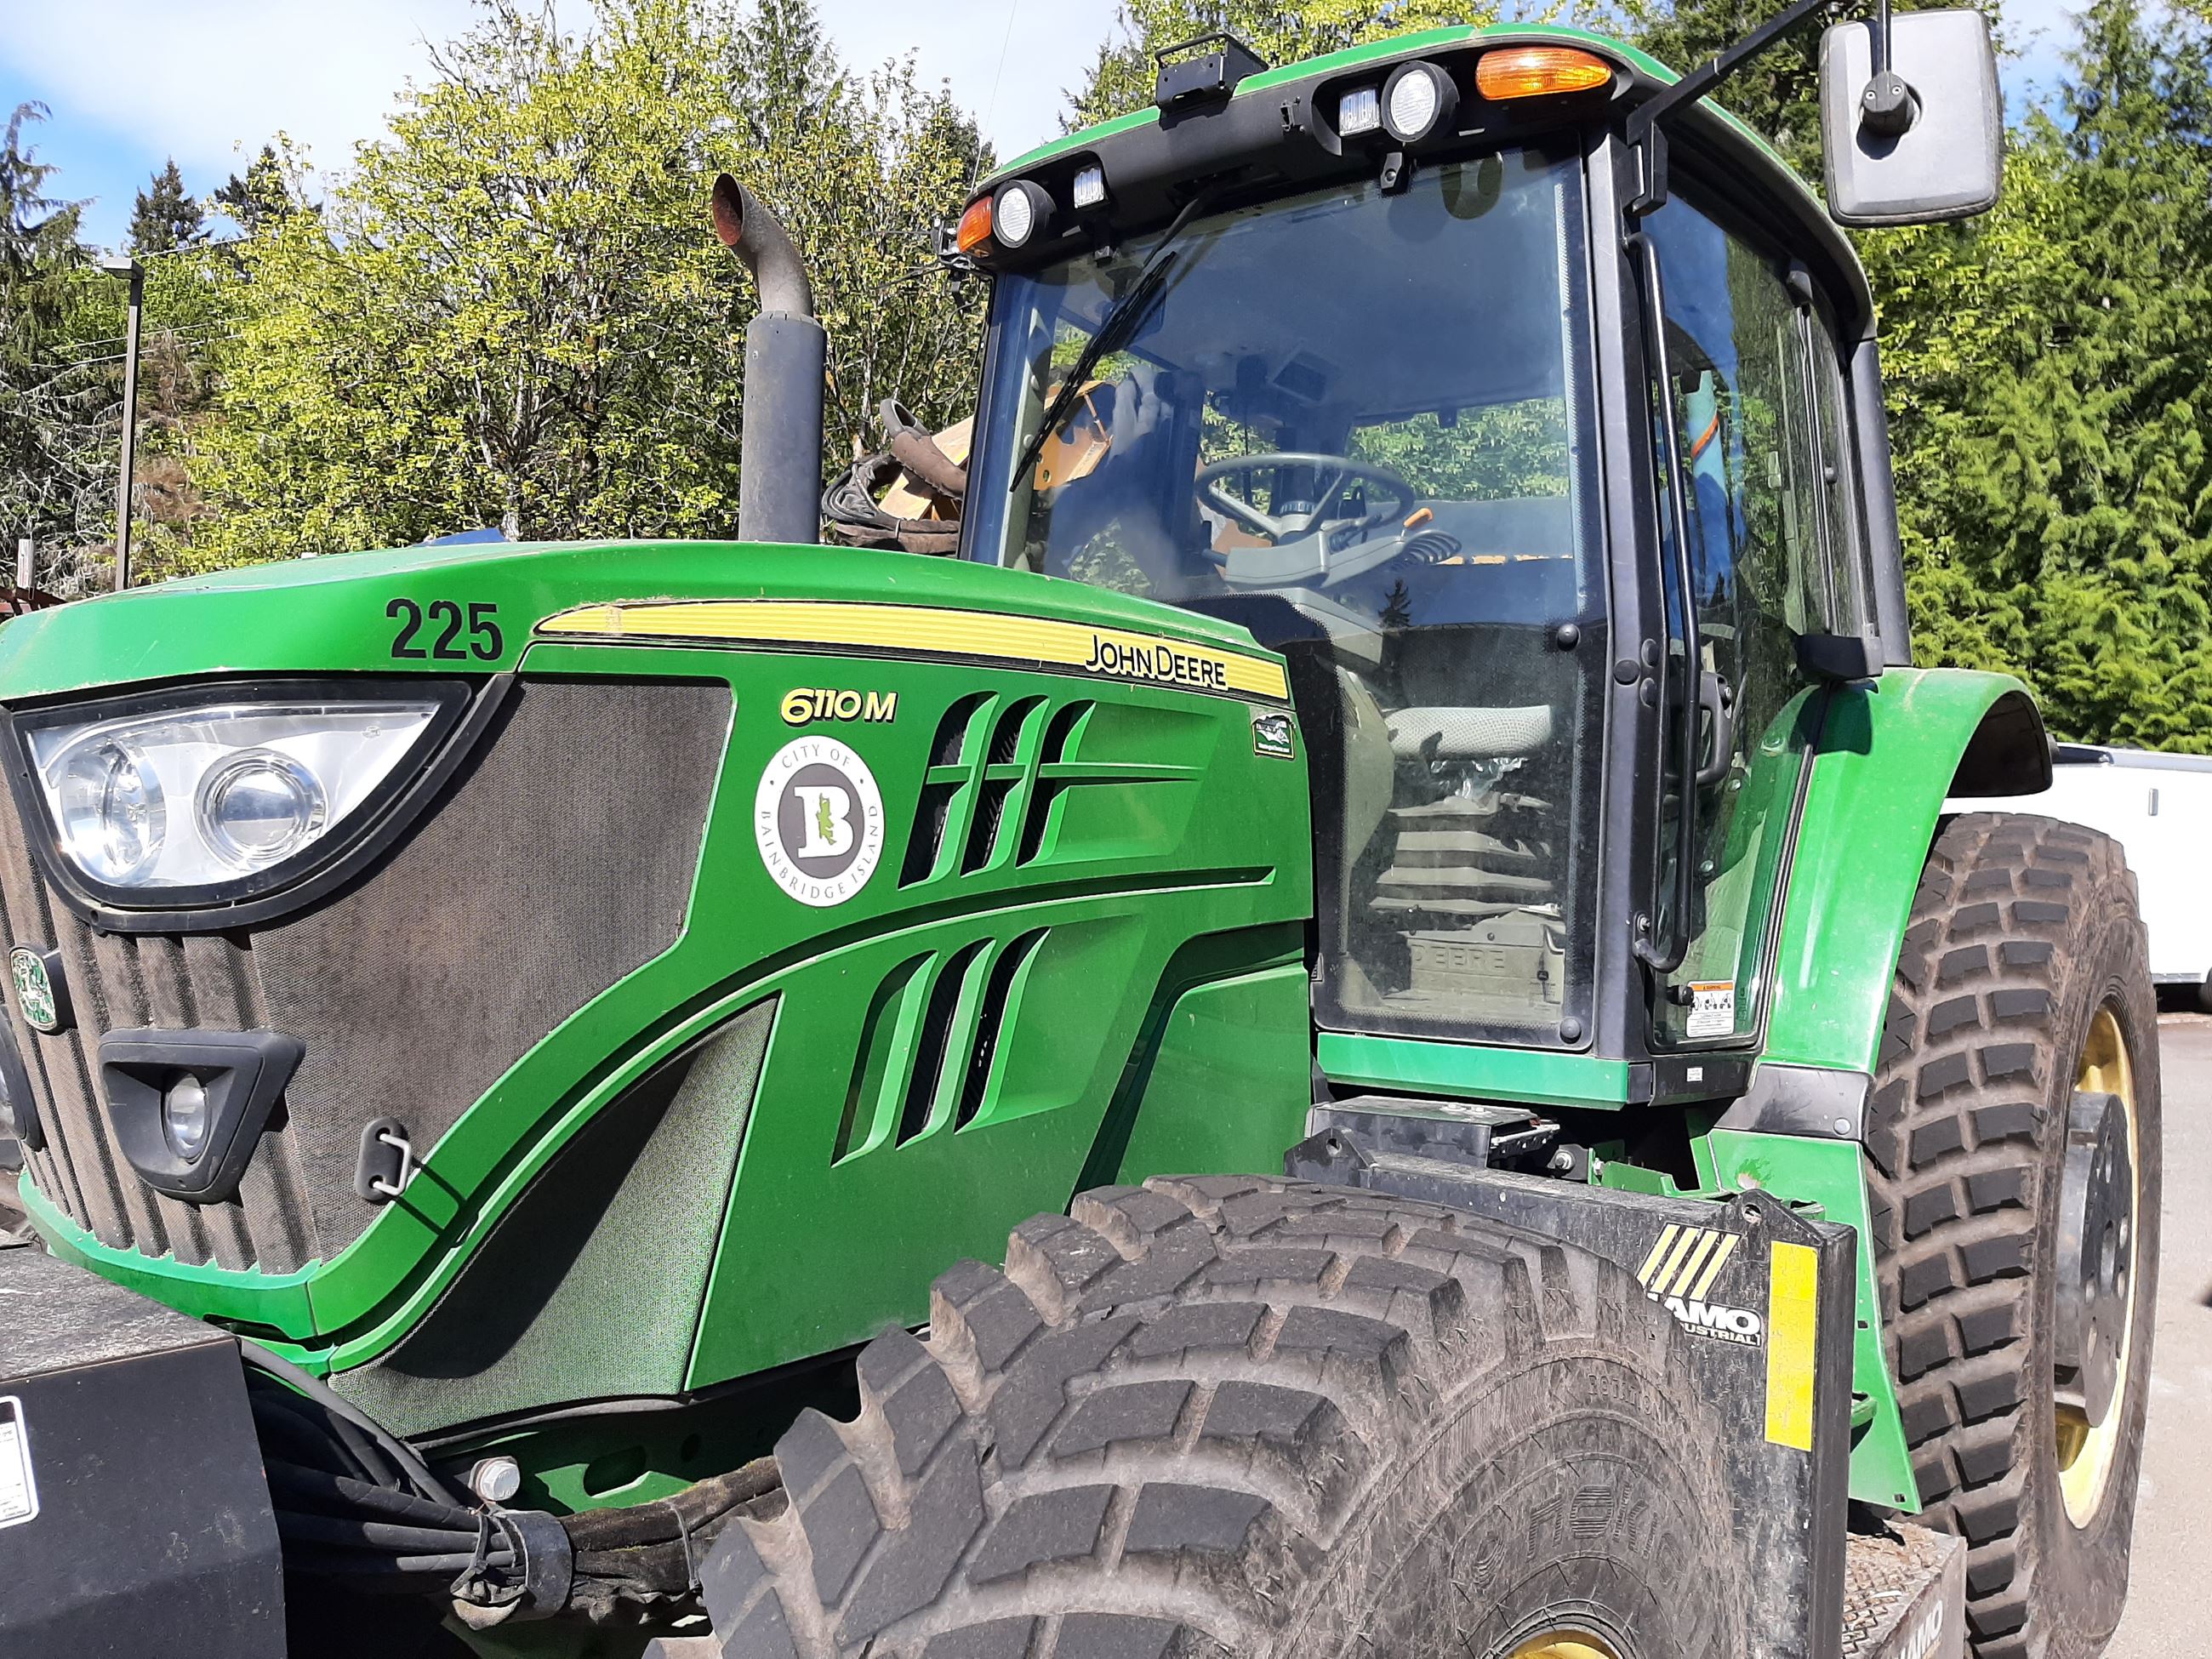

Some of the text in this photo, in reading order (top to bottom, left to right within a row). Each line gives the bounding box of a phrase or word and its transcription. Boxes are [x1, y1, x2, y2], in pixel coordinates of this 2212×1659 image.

[386, 598, 504, 661] 225
[1086, 635, 1227, 687] JOHN DEERE
[782, 744, 850, 768] CITY OF
[794, 785, 854, 858] B
[761, 806, 878, 899] BAINBRIDGE ISLAND
[1646, 1292, 1760, 1336] AMO
[1679, 1323, 1757, 1346] USTRIAL
